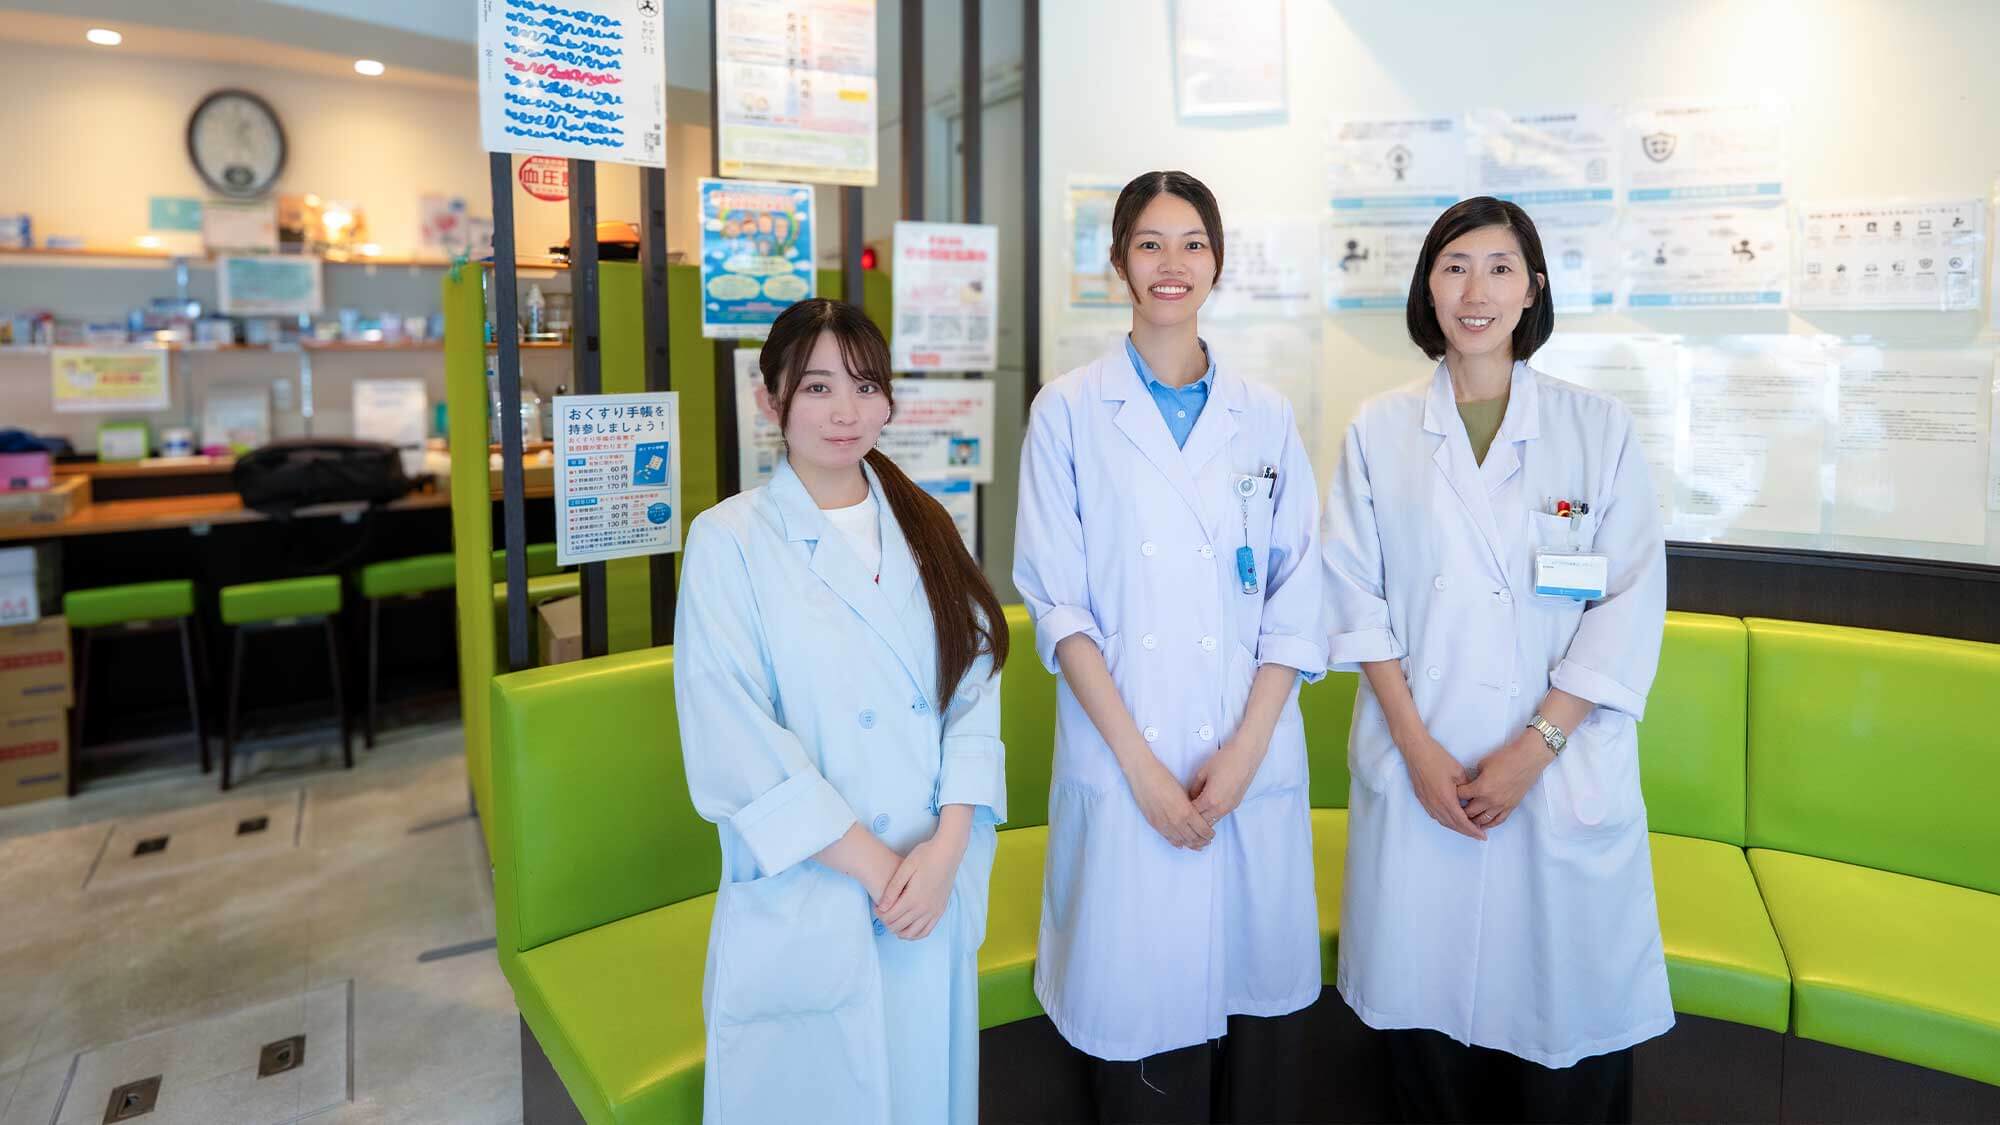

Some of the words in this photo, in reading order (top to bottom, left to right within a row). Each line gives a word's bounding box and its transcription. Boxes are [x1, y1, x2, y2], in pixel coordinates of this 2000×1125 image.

[568, 405, 664, 420] おくすり手帳を
[568, 421, 664, 435] 持参しましょう！
